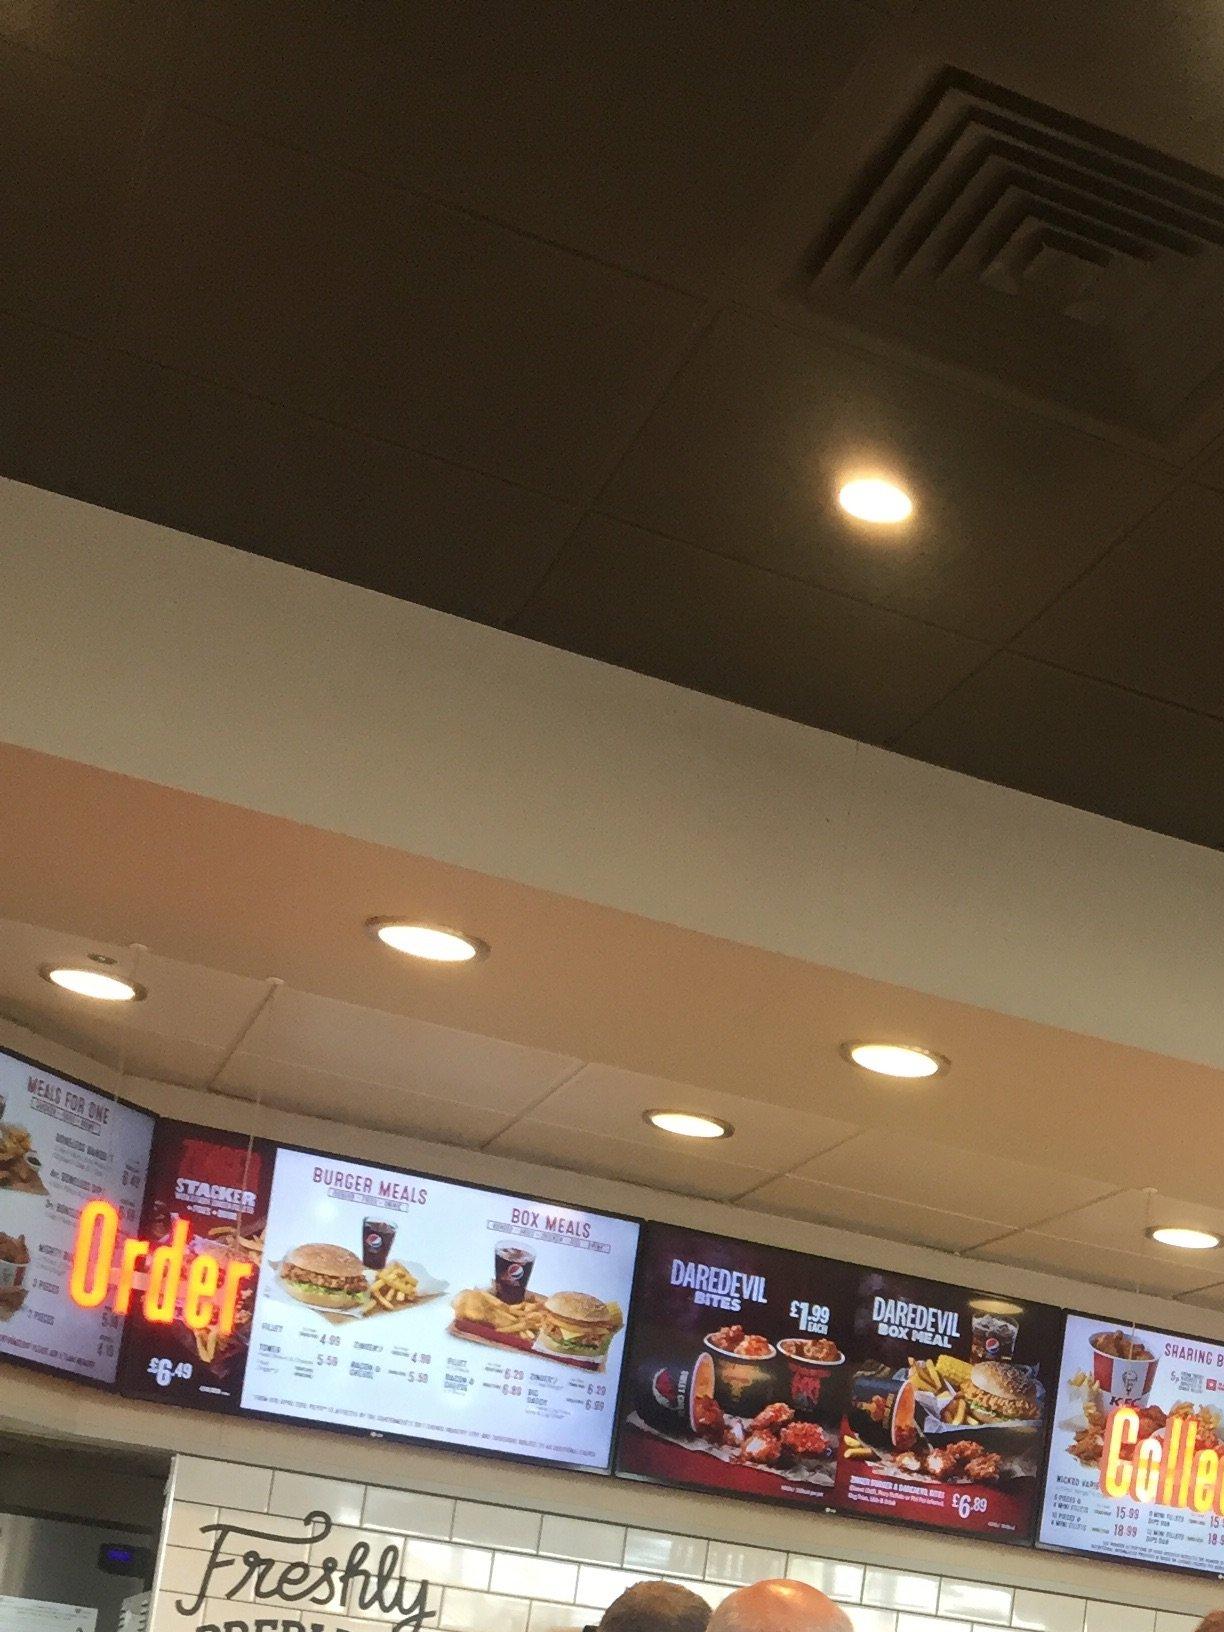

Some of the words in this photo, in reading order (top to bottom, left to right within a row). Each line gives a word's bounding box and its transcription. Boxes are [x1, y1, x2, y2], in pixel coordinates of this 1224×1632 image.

[65, 1092, 86, 1115] FOR
[88, 1102, 110, 1125] ONE
[175, 1177, 257, 1207] STACKER
[312, 1167, 373, 1194] BURGER
[378, 1180, 428, 1205] MEALS
[511, 1208, 540, 1229] BOX
[545, 1215, 592, 1239] MEALS
[70, 1199, 254, 1336] Order
[670, 1259, 768, 1304] DAREDEVIL
[694, 1291, 742, 1312] BITES
[789, 1300, 830, 1331] £1.99
[807, 1320, 828, 1335] EACH
[872, 1296, 960, 1338] DAREDEVIL
[878, 1322, 909, 1340] BOX
[911, 1329, 952, 1349] MEAL
[1164, 1342, 1213, 1365] SHARING
[147, 1357, 193, 1386] £6.49
[952, 1493, 988, 1519] £6.89
